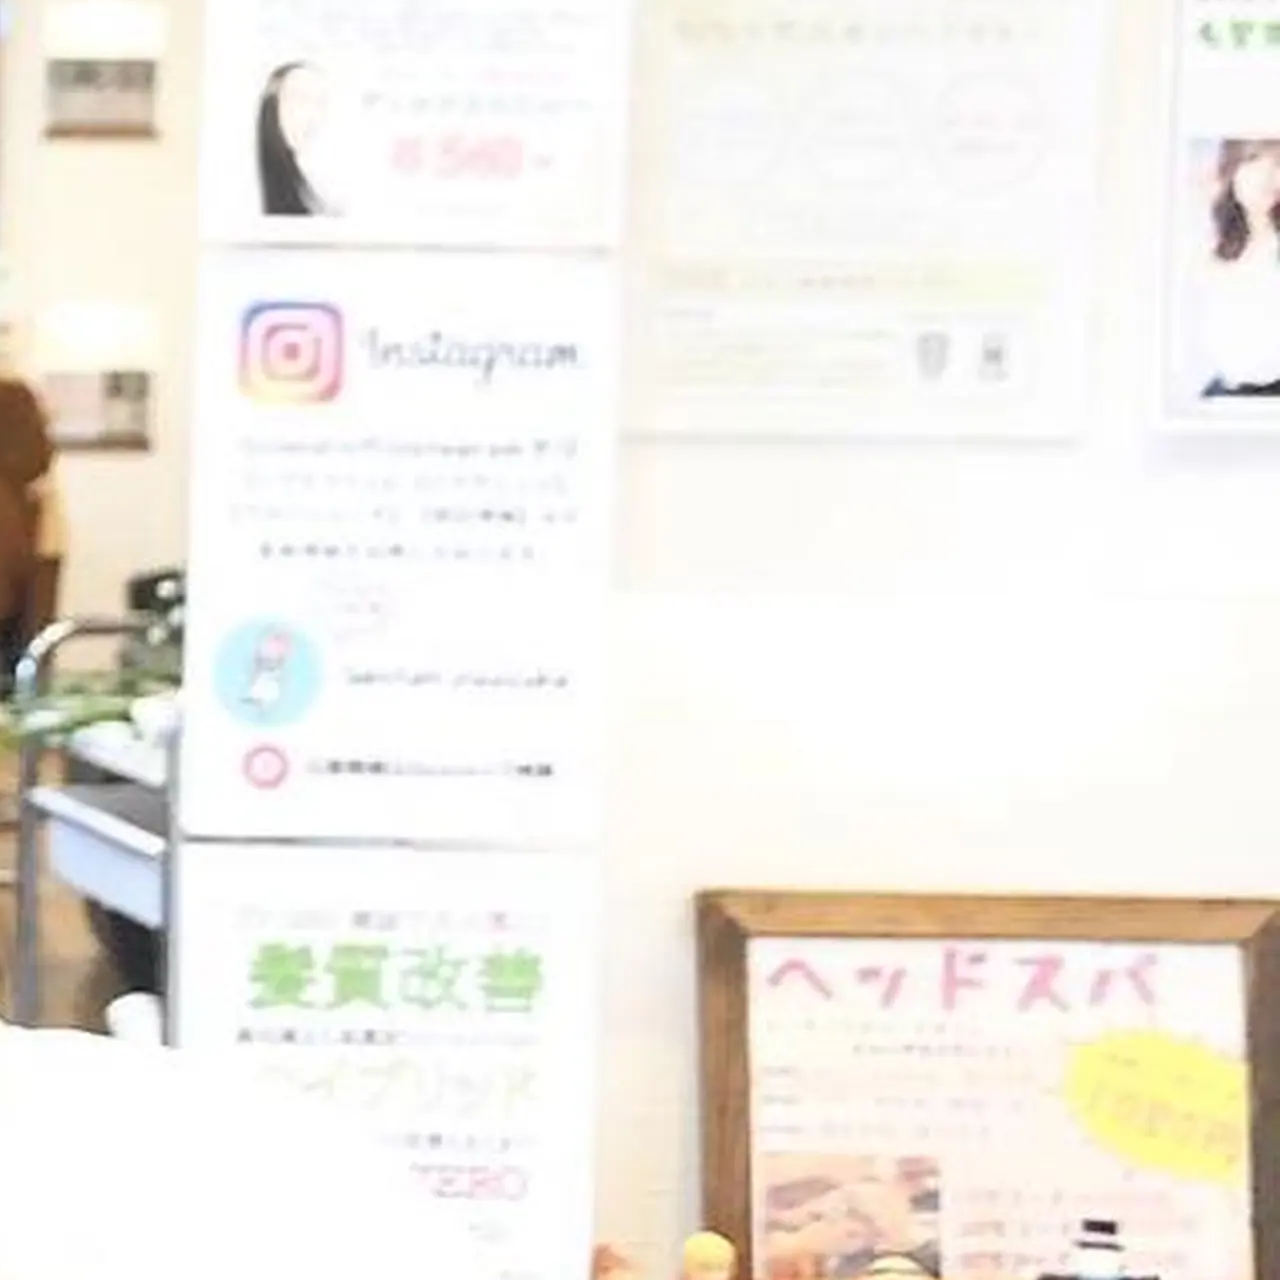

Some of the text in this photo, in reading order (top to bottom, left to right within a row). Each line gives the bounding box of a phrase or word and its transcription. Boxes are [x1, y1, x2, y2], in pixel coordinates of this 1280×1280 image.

[366, 328, 579, 388] Instagram
[765, 945, 1159, 1013] ヘッドスパ
